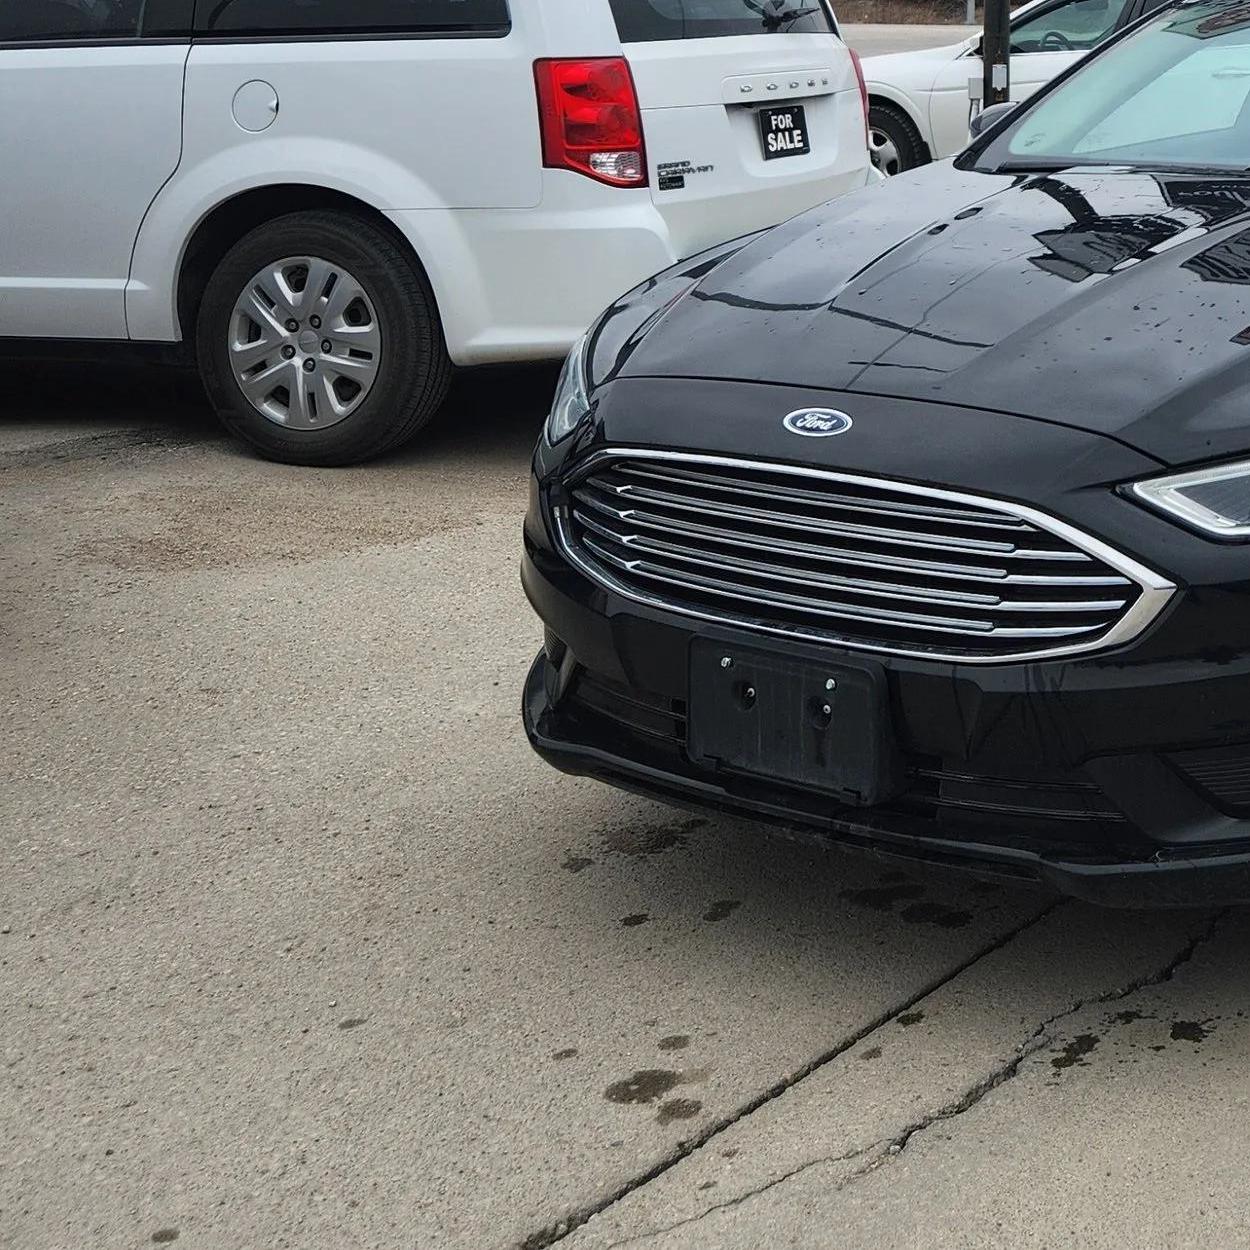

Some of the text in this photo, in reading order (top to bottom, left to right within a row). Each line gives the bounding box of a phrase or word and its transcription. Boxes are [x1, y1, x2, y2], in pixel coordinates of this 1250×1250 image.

[740, 78, 829, 93] DODGE
[771, 113, 794, 130] FOR
[767, 129, 804, 152] SALE
[796, 412, 838, 431] Ford
